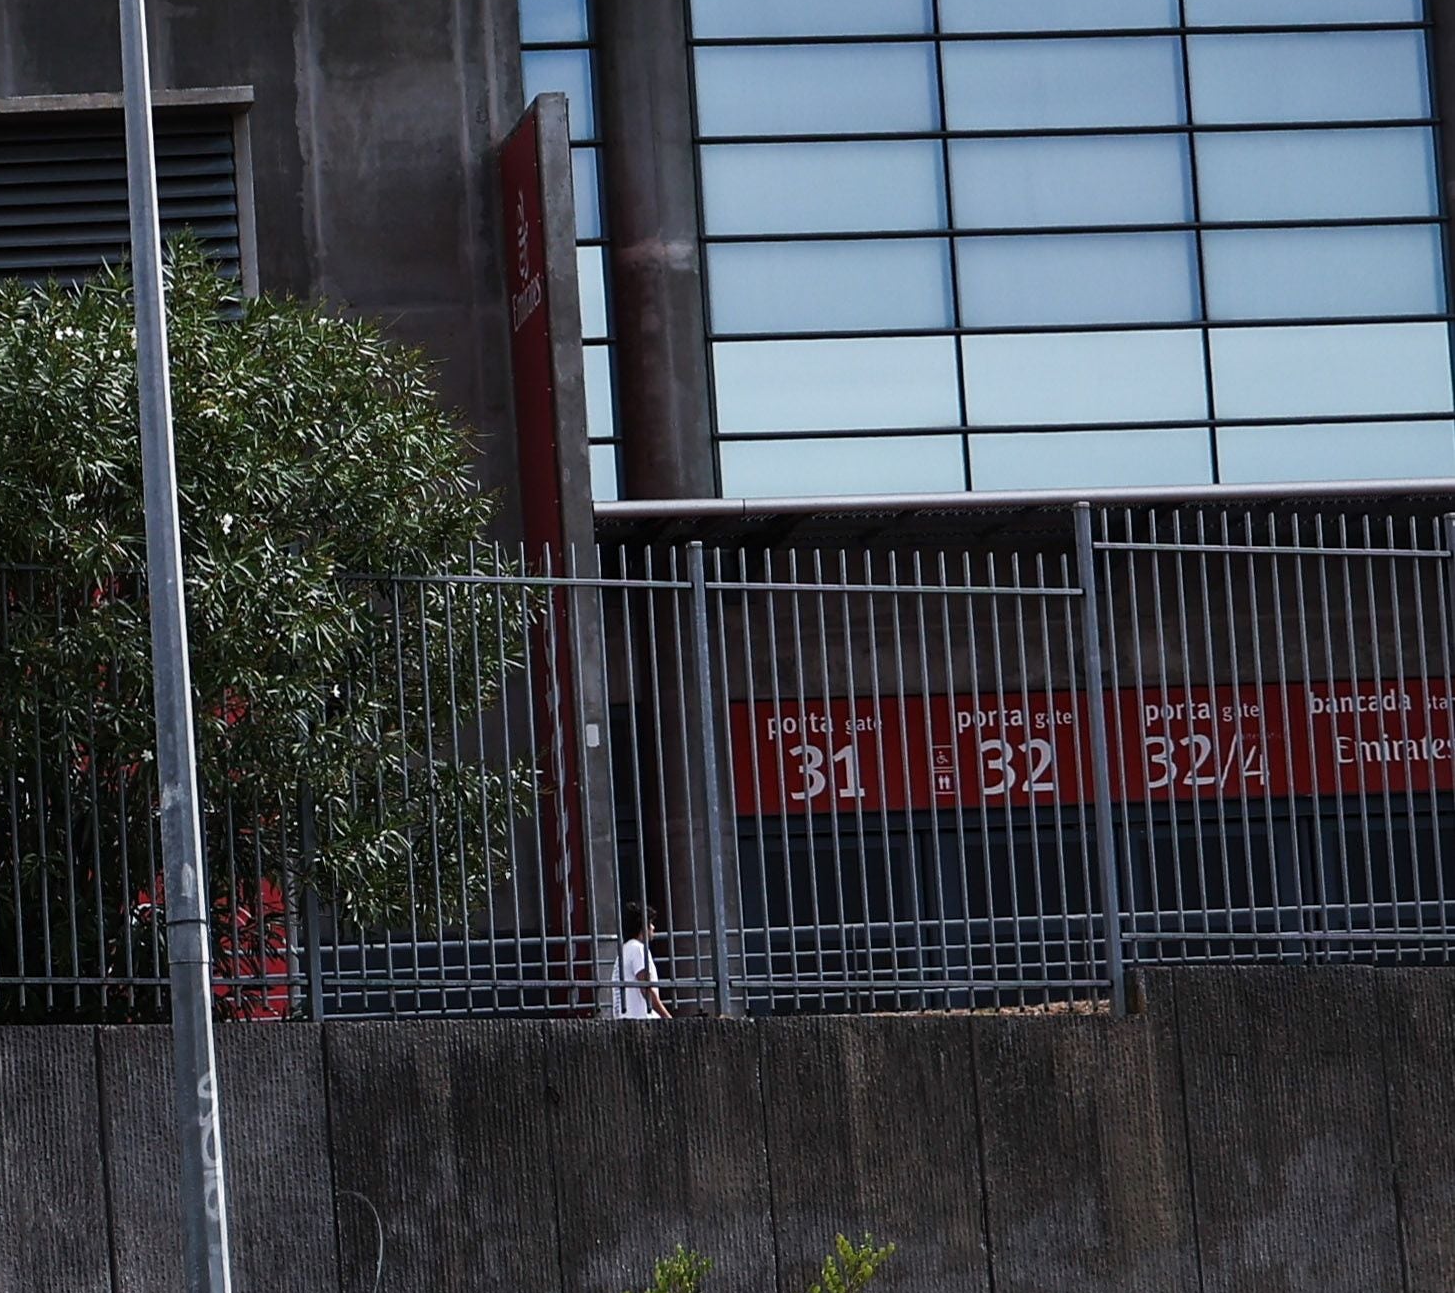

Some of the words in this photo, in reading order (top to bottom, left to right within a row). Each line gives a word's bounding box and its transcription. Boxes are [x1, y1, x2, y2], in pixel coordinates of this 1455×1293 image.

[957, 709, 1023, 733] porta
[1035, 709, 1072, 729] gte
[1145, 702, 1211, 727] porta
[1222, 703, 1260, 722] gte
[1310, 688, 1412, 714] bancada
[788, 744, 865, 800] 31
[980, 738, 1054, 795] 32
[1145, 733, 1270, 789] 32/4
